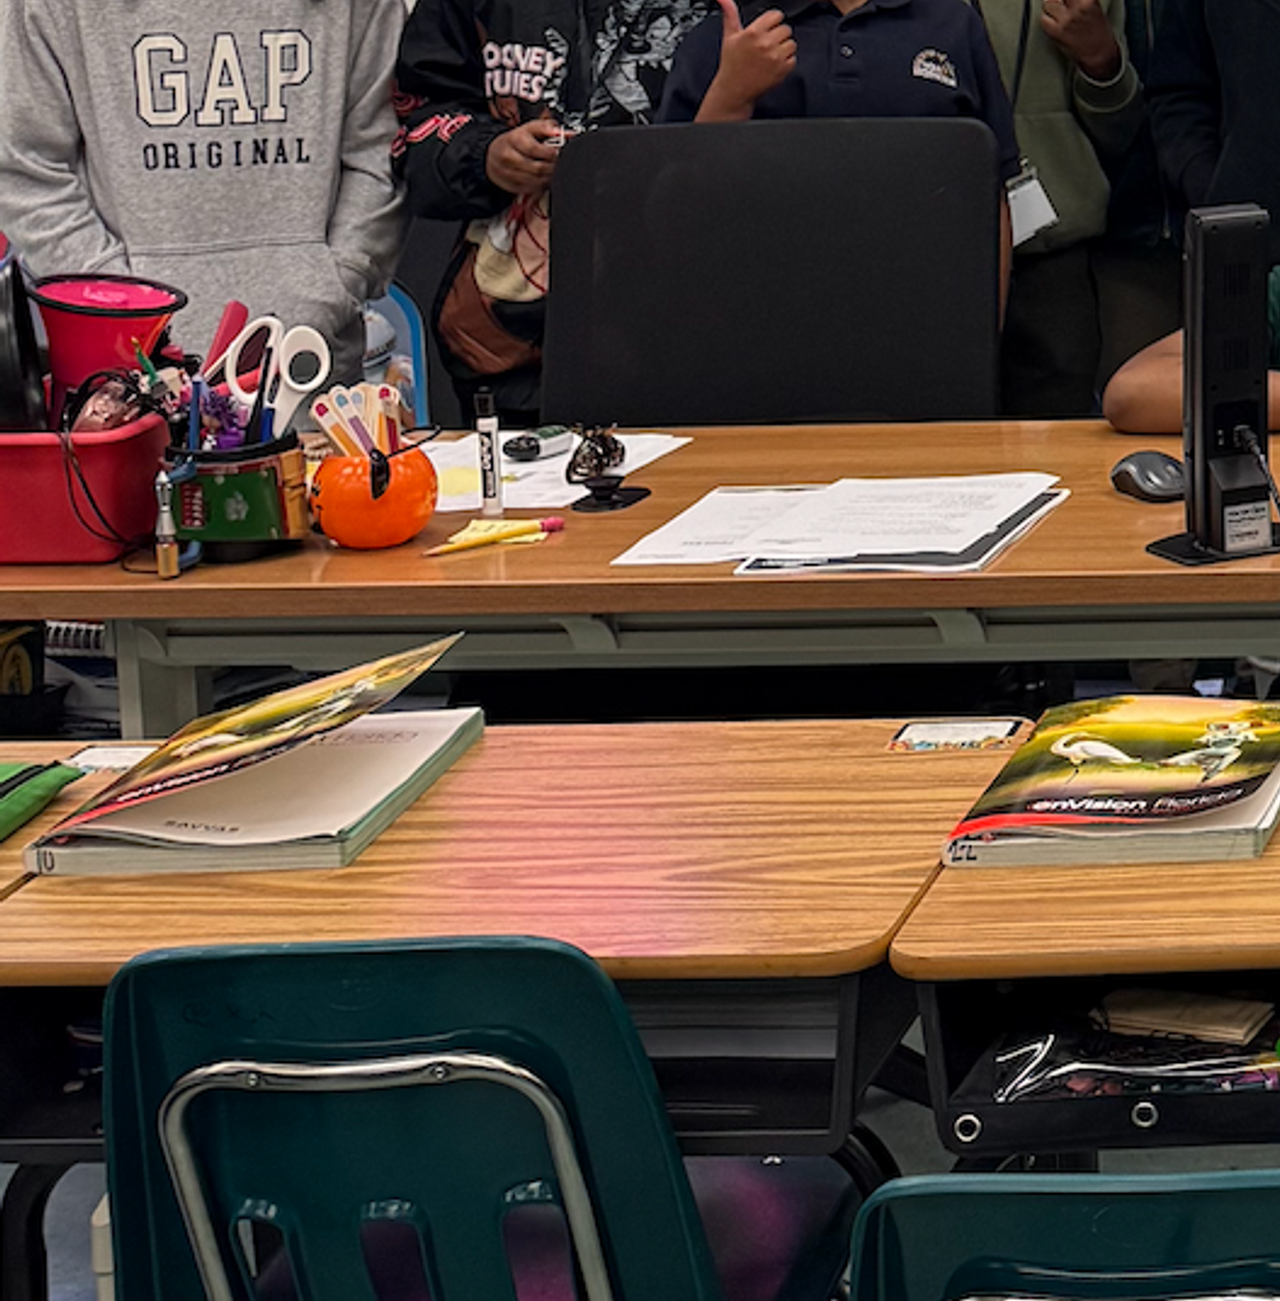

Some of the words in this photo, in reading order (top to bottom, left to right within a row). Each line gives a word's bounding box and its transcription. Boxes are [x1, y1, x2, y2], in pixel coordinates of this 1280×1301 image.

[131, 29, 313, 128] GAP
[142, 136, 311, 171] ORIGINAL
[1032, 797, 1148, 814] enVision
[1153, 787, 1244, 812] Florida
[163, 819, 241, 834] SAVVAS
